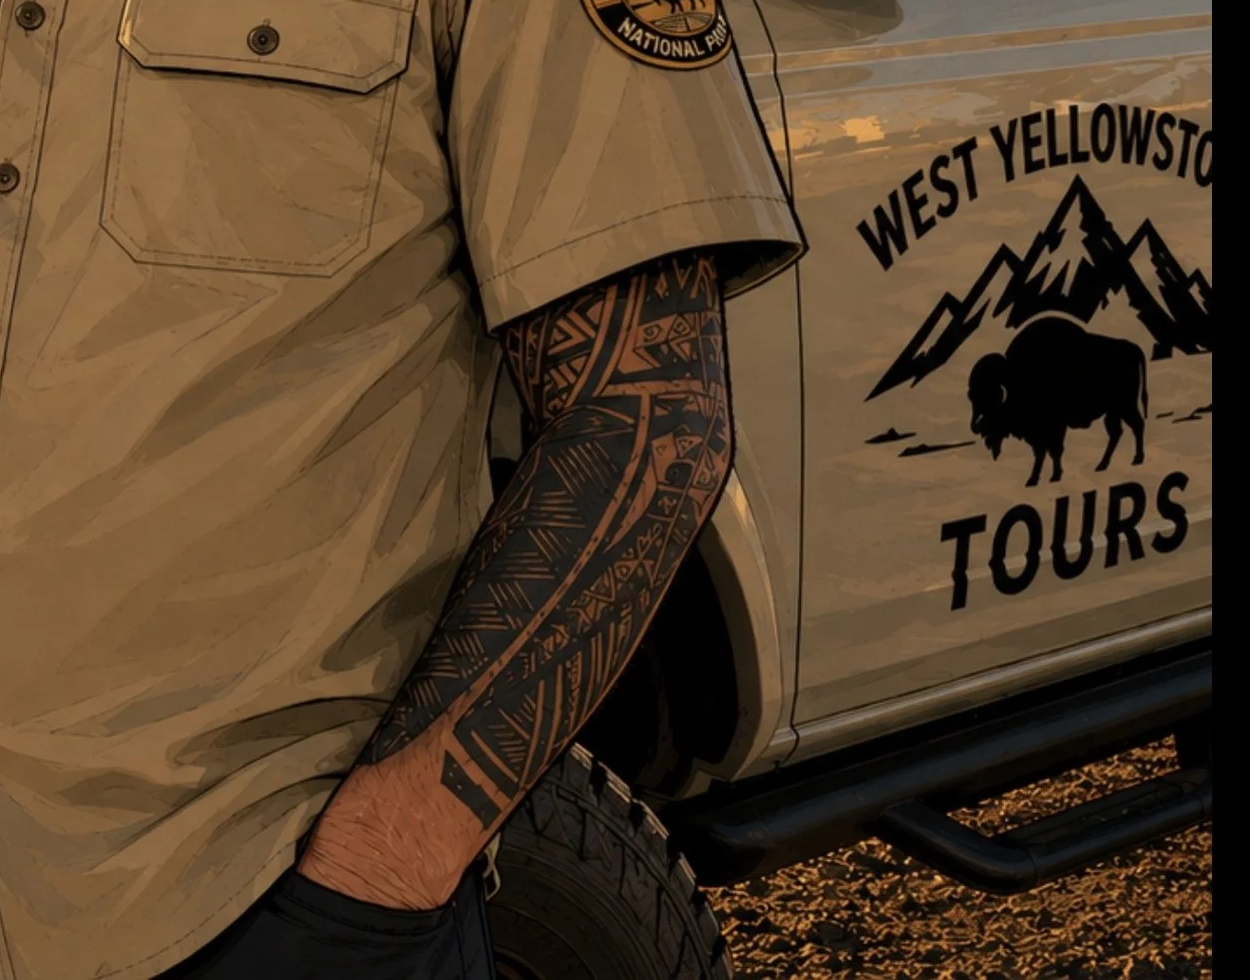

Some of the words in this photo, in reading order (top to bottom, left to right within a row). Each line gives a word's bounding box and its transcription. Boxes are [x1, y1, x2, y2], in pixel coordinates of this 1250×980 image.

[617, 17, 705, 58] NATIONAL
[856, 136, 978, 271] WEST
[989, 103, 1213, 188] YELLOWSTO
[940, 471, 1190, 611] TOURS
